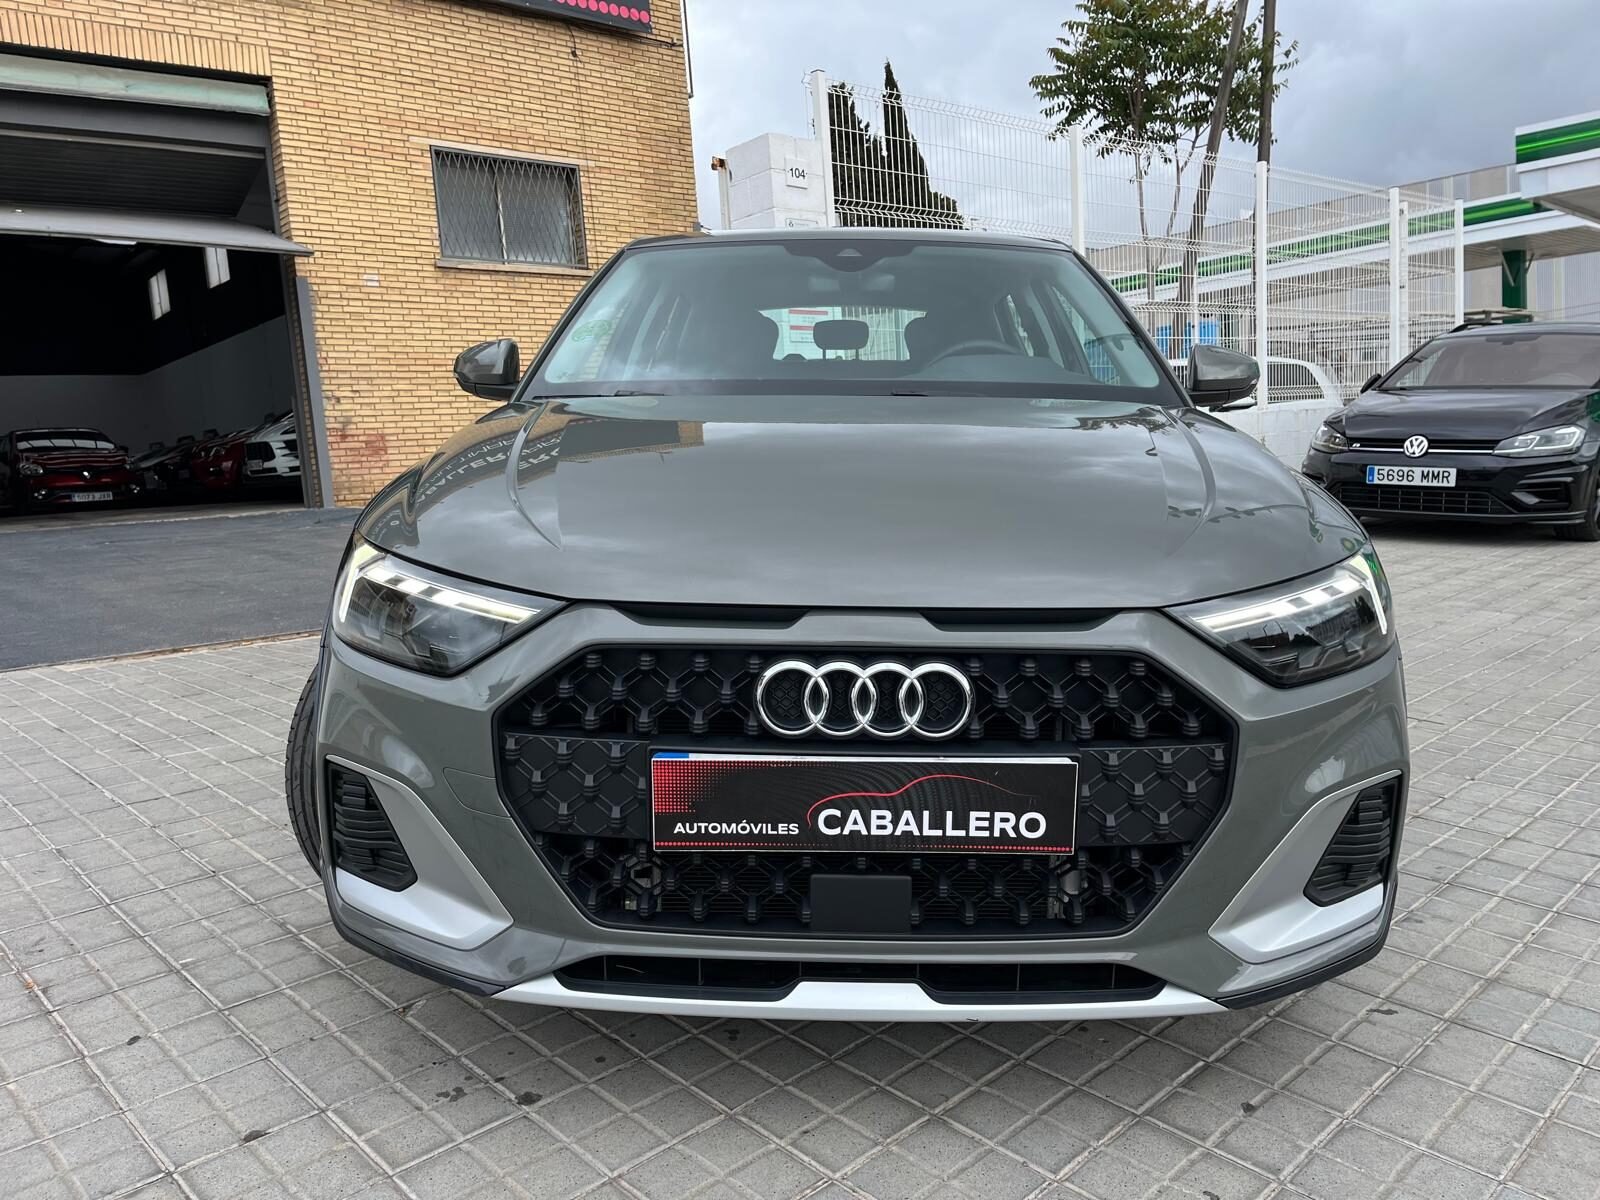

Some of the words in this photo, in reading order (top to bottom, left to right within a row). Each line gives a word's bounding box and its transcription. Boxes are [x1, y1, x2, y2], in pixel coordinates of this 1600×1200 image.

[789, 167, 806, 180] 104
[1376, 468, 1415, 483] 5696
[1420, 469, 1451, 484] MMR
[673, 819, 800, 835] AUTOMÓVILES
[817, 808, 1047, 839] CABALLERO
